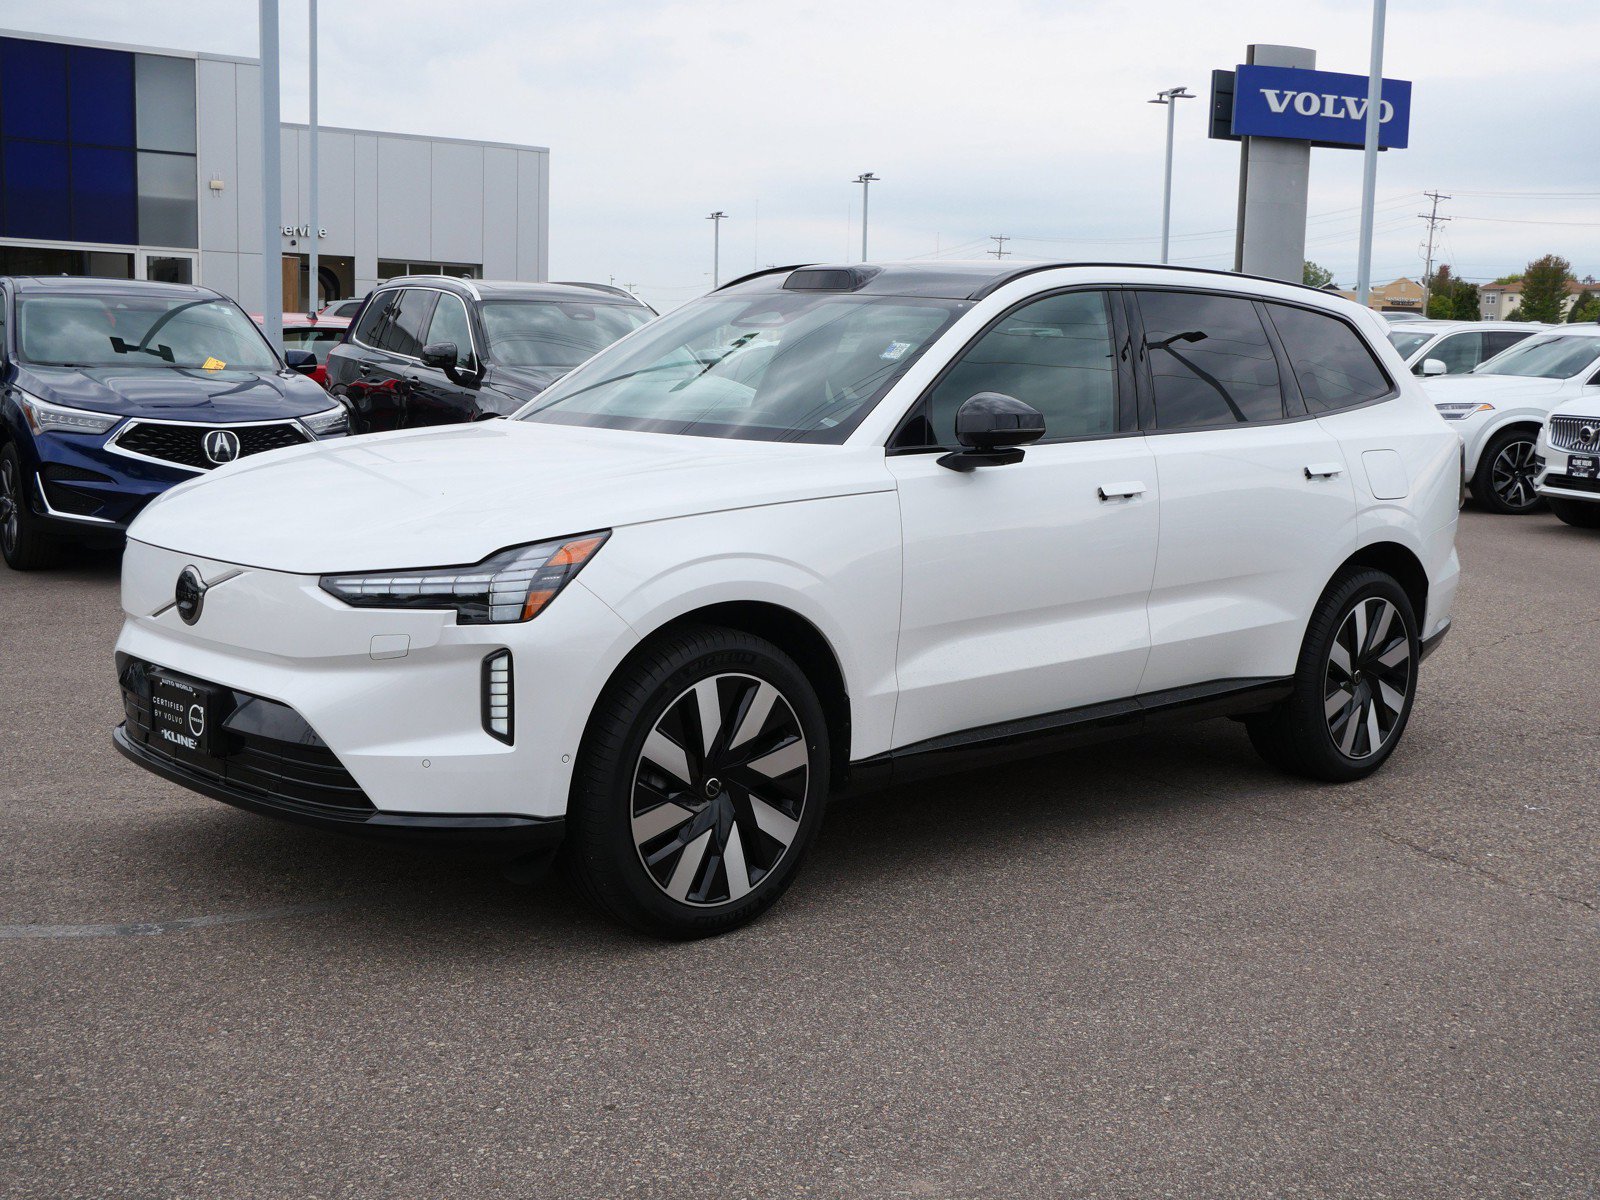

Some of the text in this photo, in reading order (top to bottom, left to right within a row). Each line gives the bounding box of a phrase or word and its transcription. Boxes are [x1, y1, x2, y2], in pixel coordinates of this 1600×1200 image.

[280, 223, 328, 239] ervie
[162, 678, 193, 692] AUTO WORLD
[152, 696, 184, 712] CERTIFIED
[154, 709, 183, 725] BY VOLVO
[163, 729, 196, 749] KLINE
